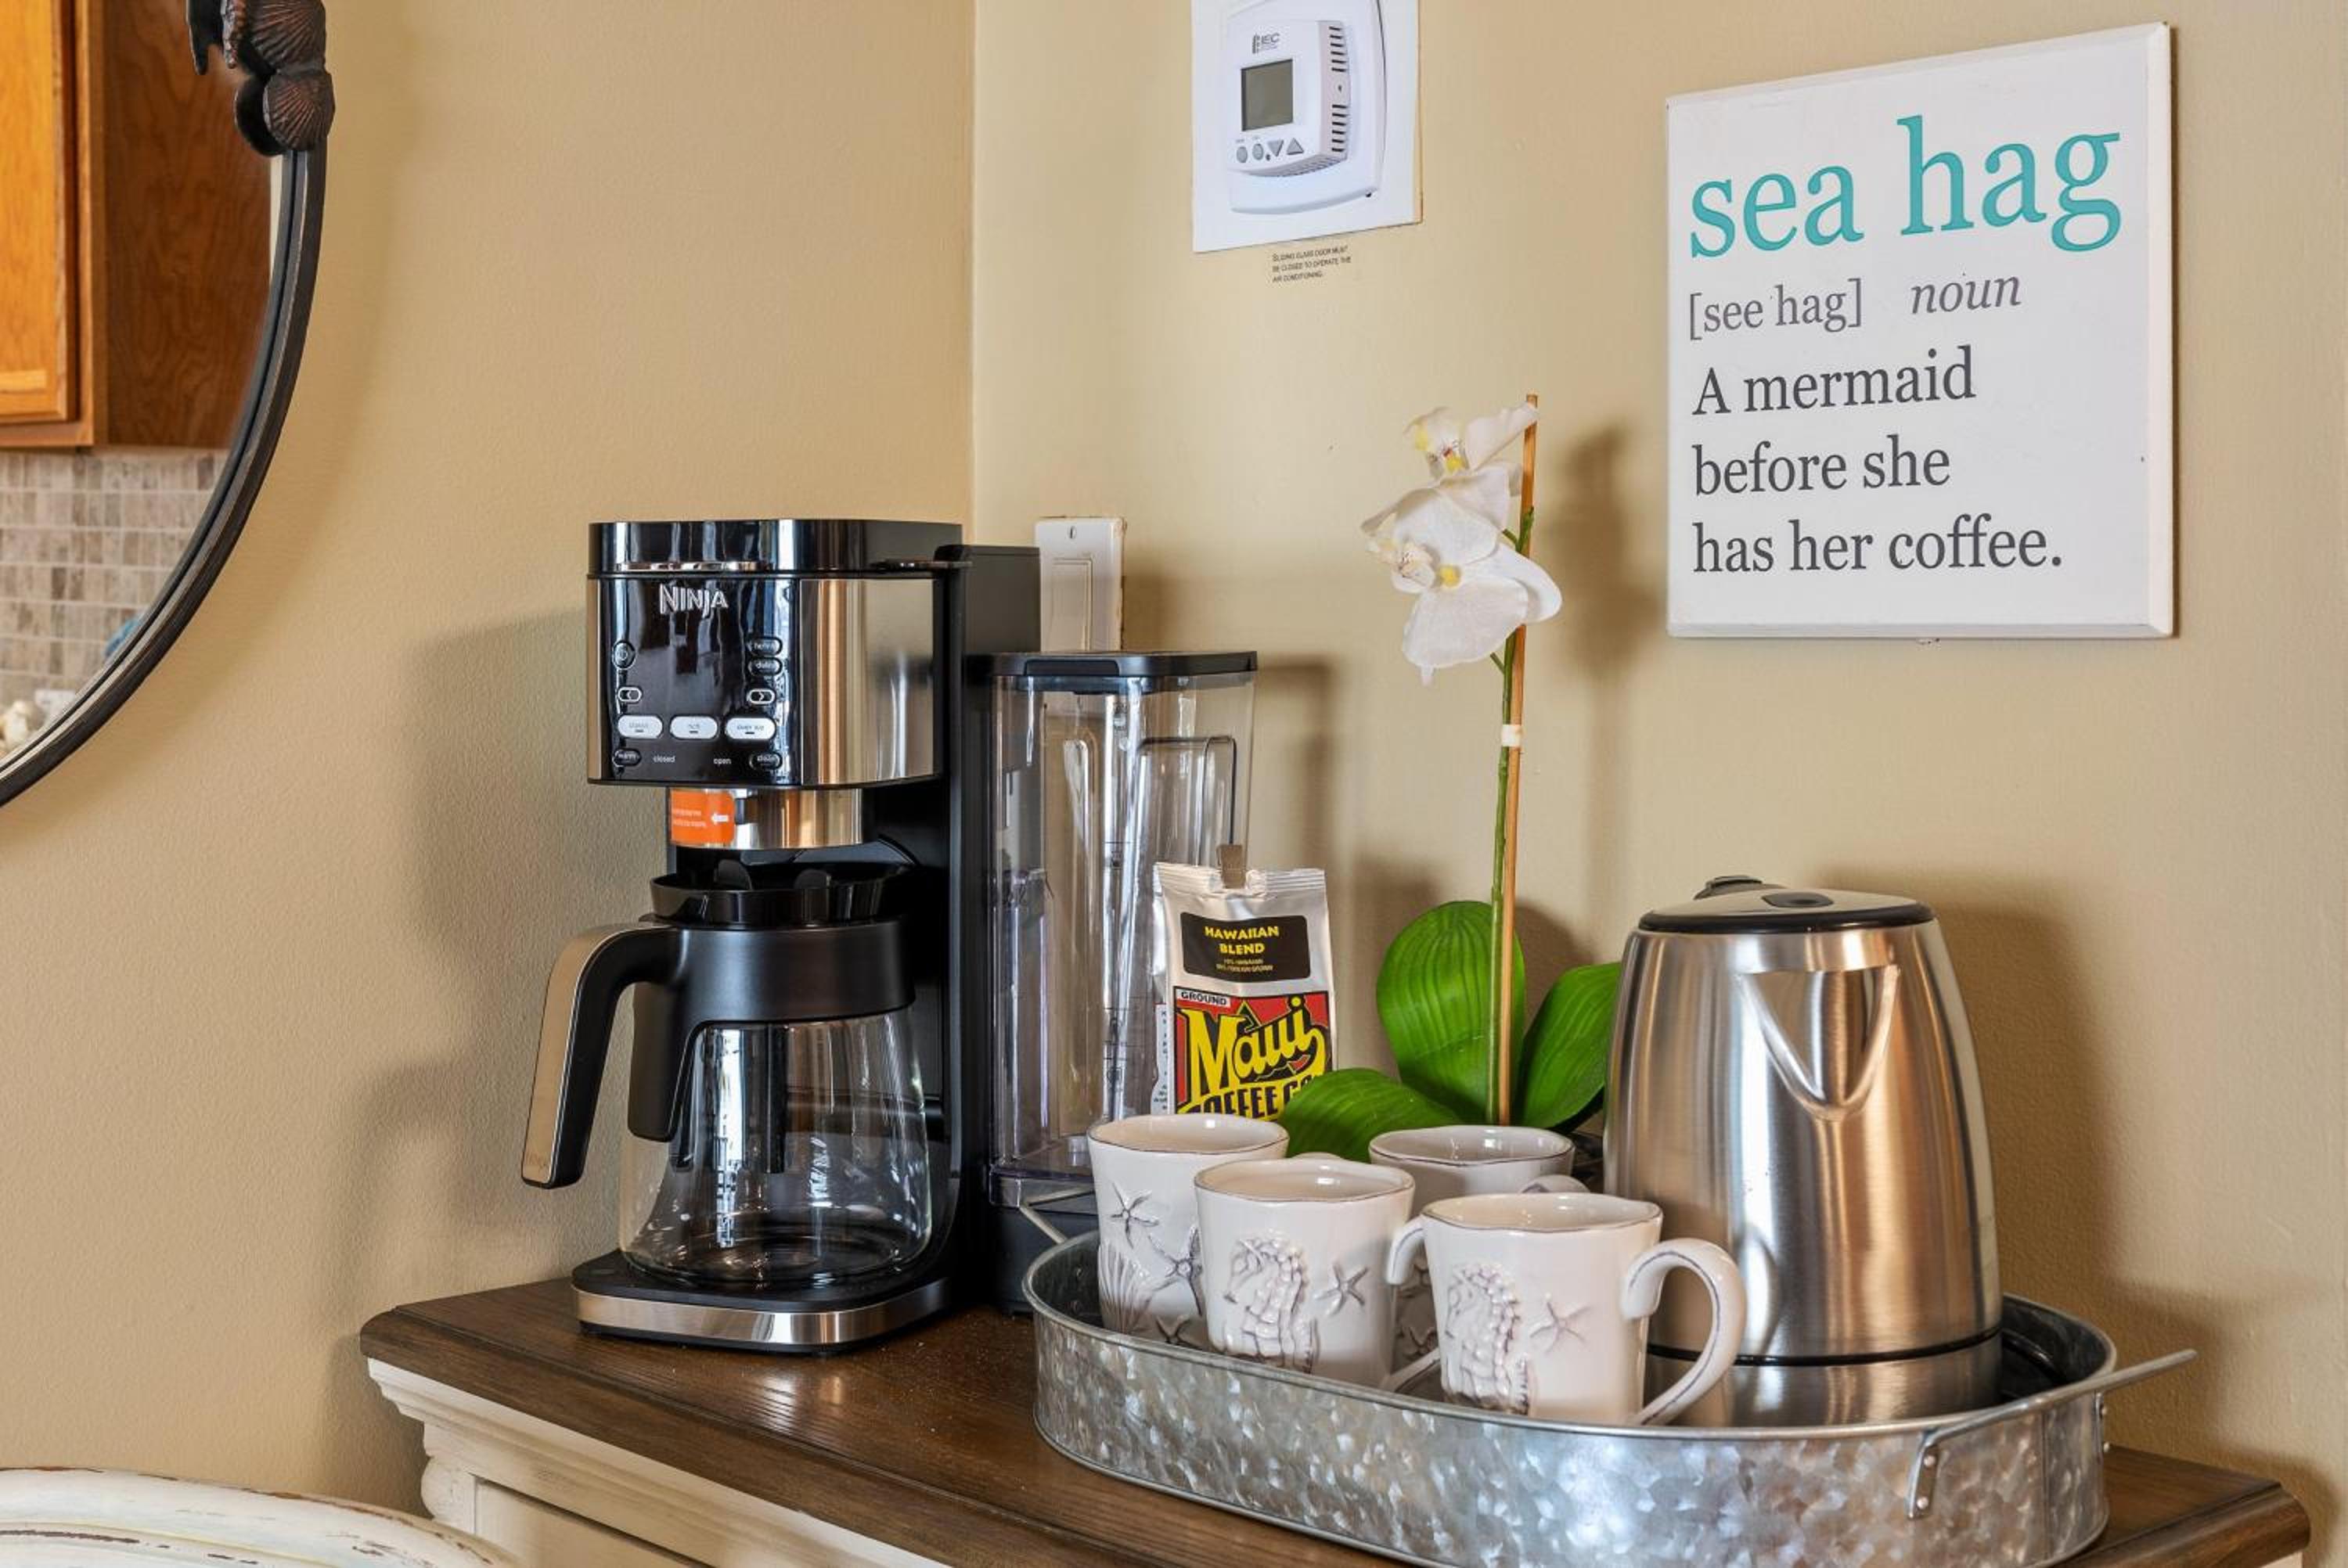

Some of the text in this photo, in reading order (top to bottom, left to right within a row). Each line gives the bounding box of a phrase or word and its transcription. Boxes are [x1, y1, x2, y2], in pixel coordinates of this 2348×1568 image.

[1690, 115, 2121, 258] sea hag
[1689, 276, 2022, 341] [see hag] noun
[1691, 344, 1977, 416] A mermaid
[1691, 433, 1950, 496] before she
[1692, 512, 2063, 573] has her coffee.
[659, 583, 729, 618] NINJA
[653, 755, 676, 764] closed
[713, 757, 732, 766] open
[1204, 926, 1279, 940] HAWAIIAN
[1219, 943, 1266, 955] BLEND
[1180, 991, 1227, 1005] GROUND
[1180, 996, 1326, 1102] Maui
